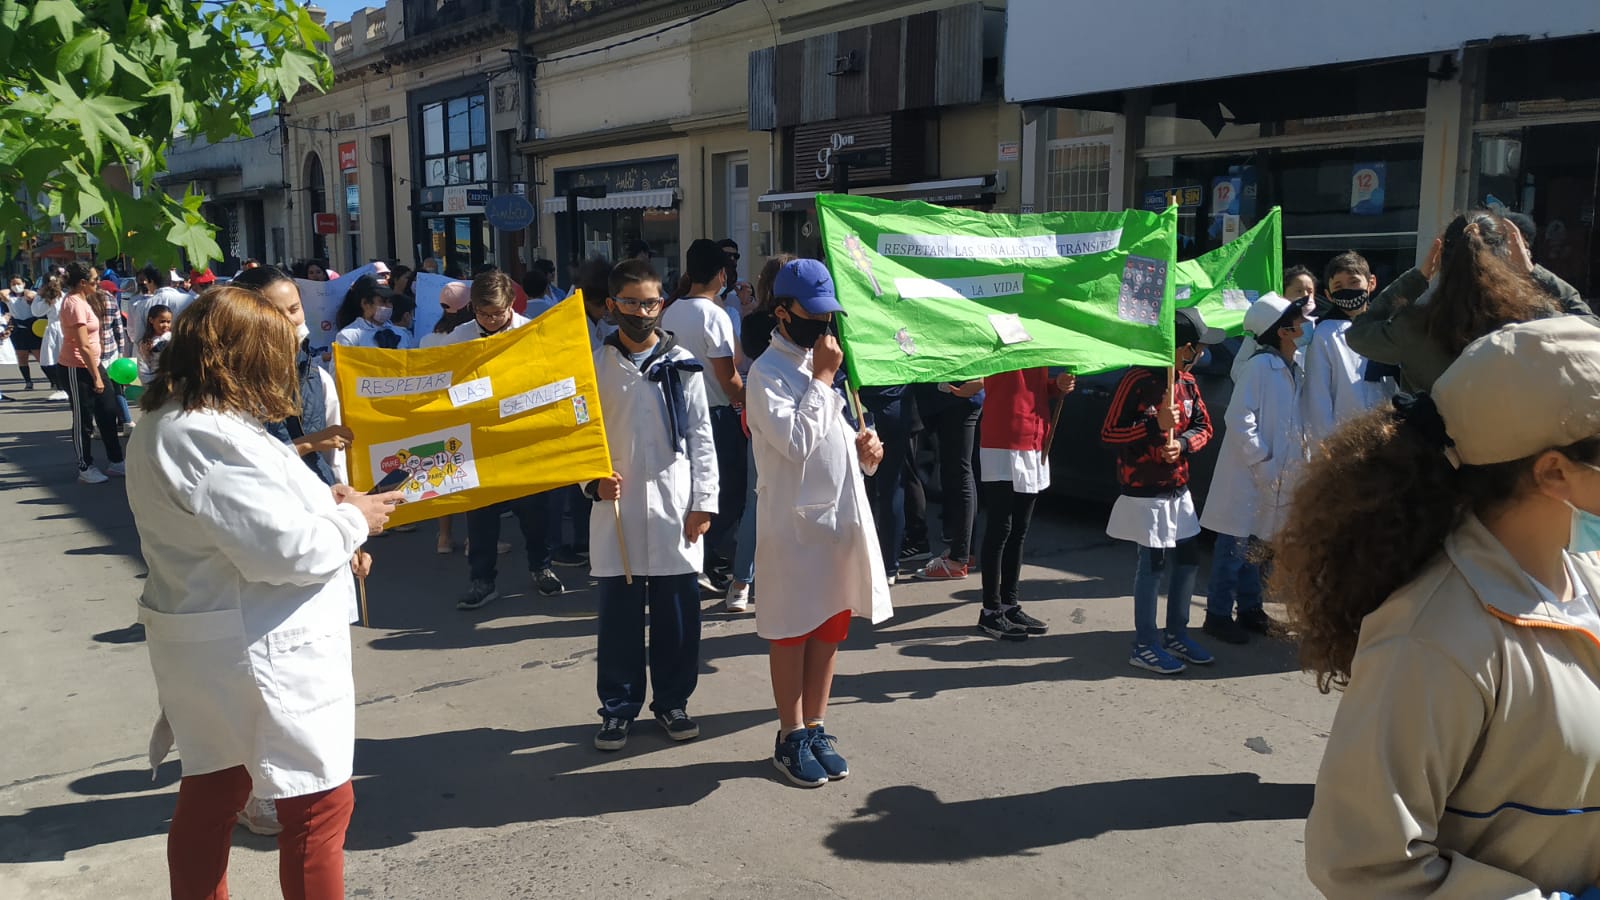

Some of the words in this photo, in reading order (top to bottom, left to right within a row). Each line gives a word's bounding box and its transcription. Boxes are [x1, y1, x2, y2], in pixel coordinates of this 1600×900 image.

[830, 133, 855, 151] Don
[1356, 173, 1372, 189] 12
[1217, 185, 1231, 201] 12
[884, 243, 944, 257] RESPETAR
[955, 245, 974, 257] LAS
[977, 242, 1026, 256] SEÑALES
[1032, 245, 1049, 257] DE
[971, 284, 985, 296] LA
[993, 280, 1020, 293] VIDA
[360, 373, 448, 394] RESPETAR
[453, 384, 487, 403] LAS
[381, 459, 400, 470] PARE
